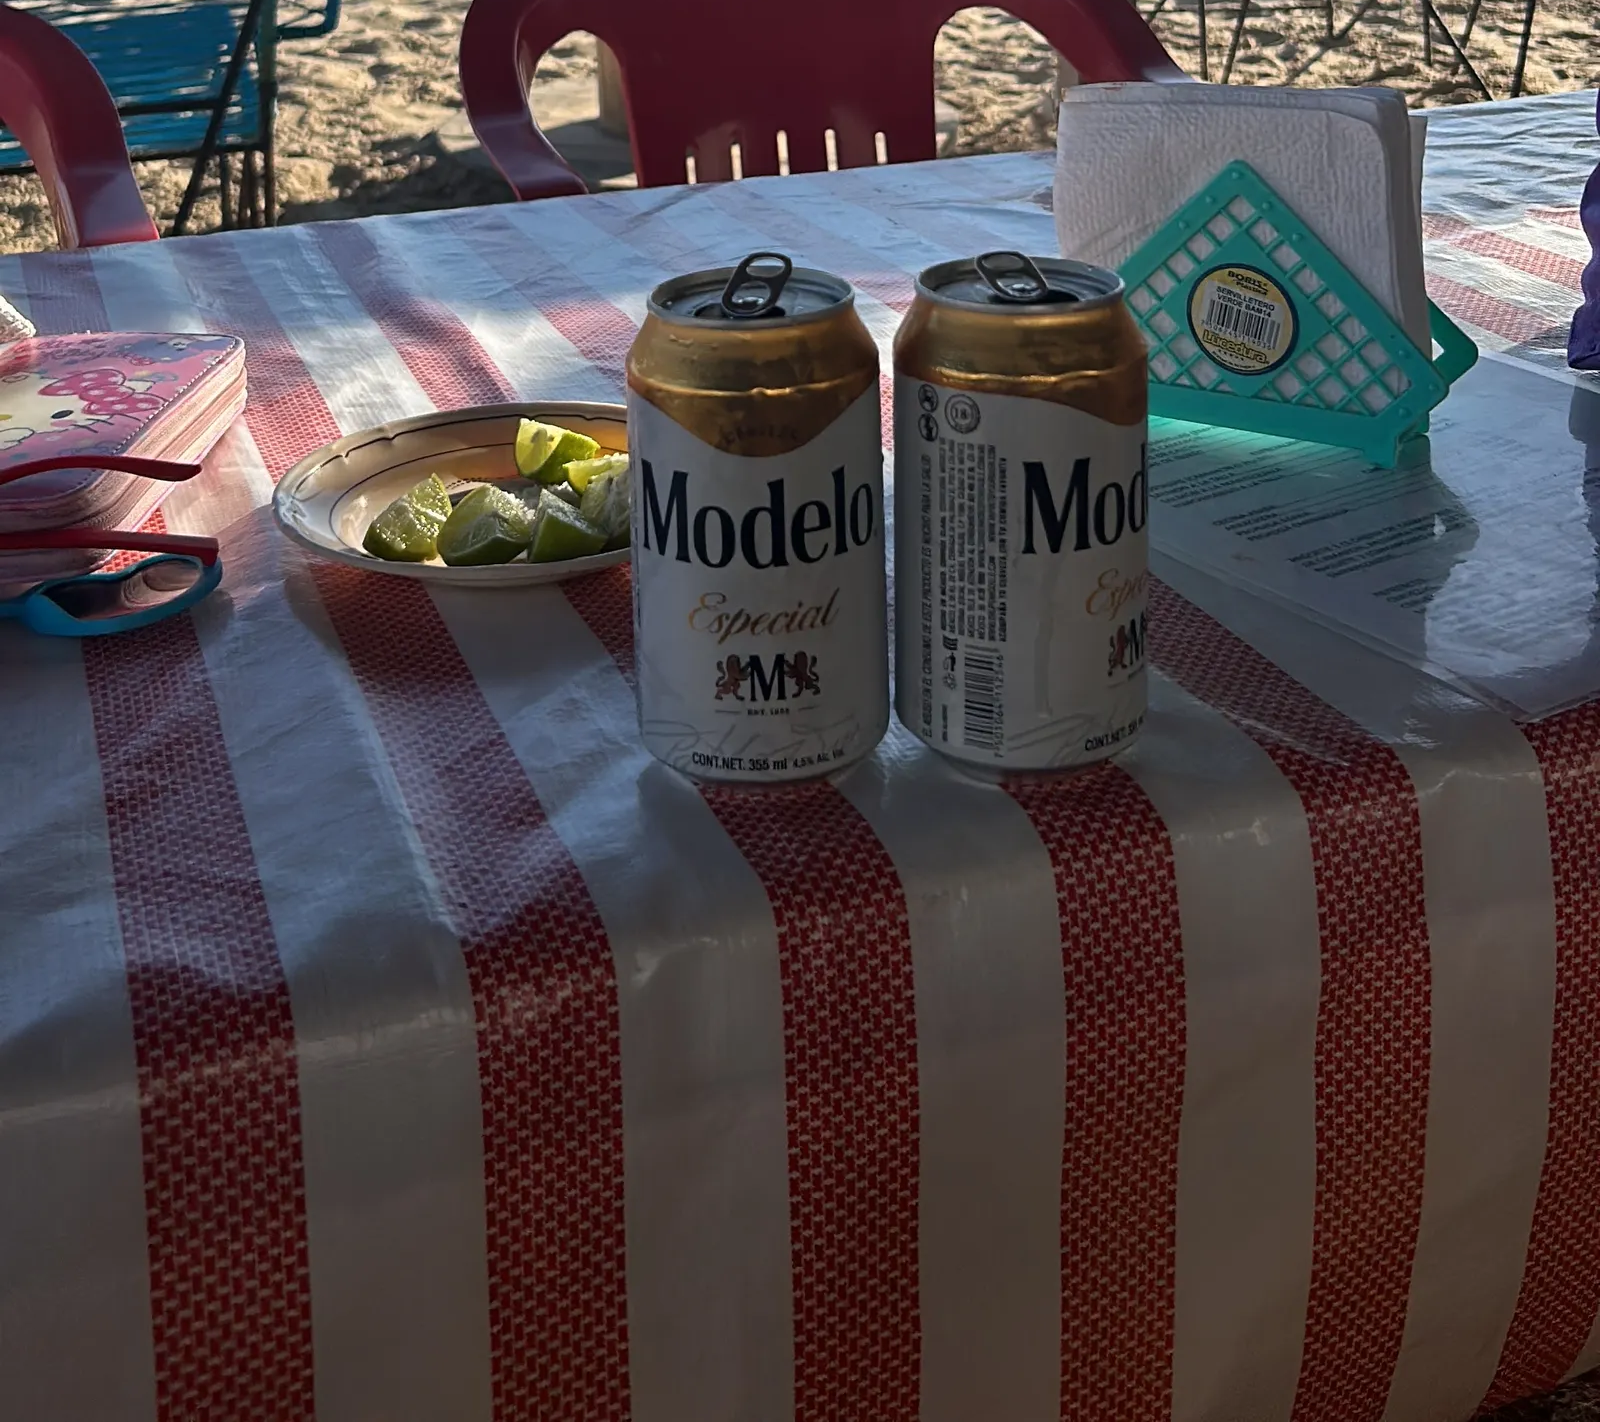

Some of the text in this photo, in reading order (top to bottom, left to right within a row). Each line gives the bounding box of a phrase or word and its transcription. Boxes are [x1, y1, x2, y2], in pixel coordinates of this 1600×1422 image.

[1216, 286, 1275, 311] SERVILLETERO
[1217, 294, 1243, 308] VERDE
[640, 458, 874, 570] Modelo
[688, 587, 841, 643] Especial
[749, 654, 787, 702] M
[748, 758, 770, 771] 355
[773, 758, 788, 771] ml
